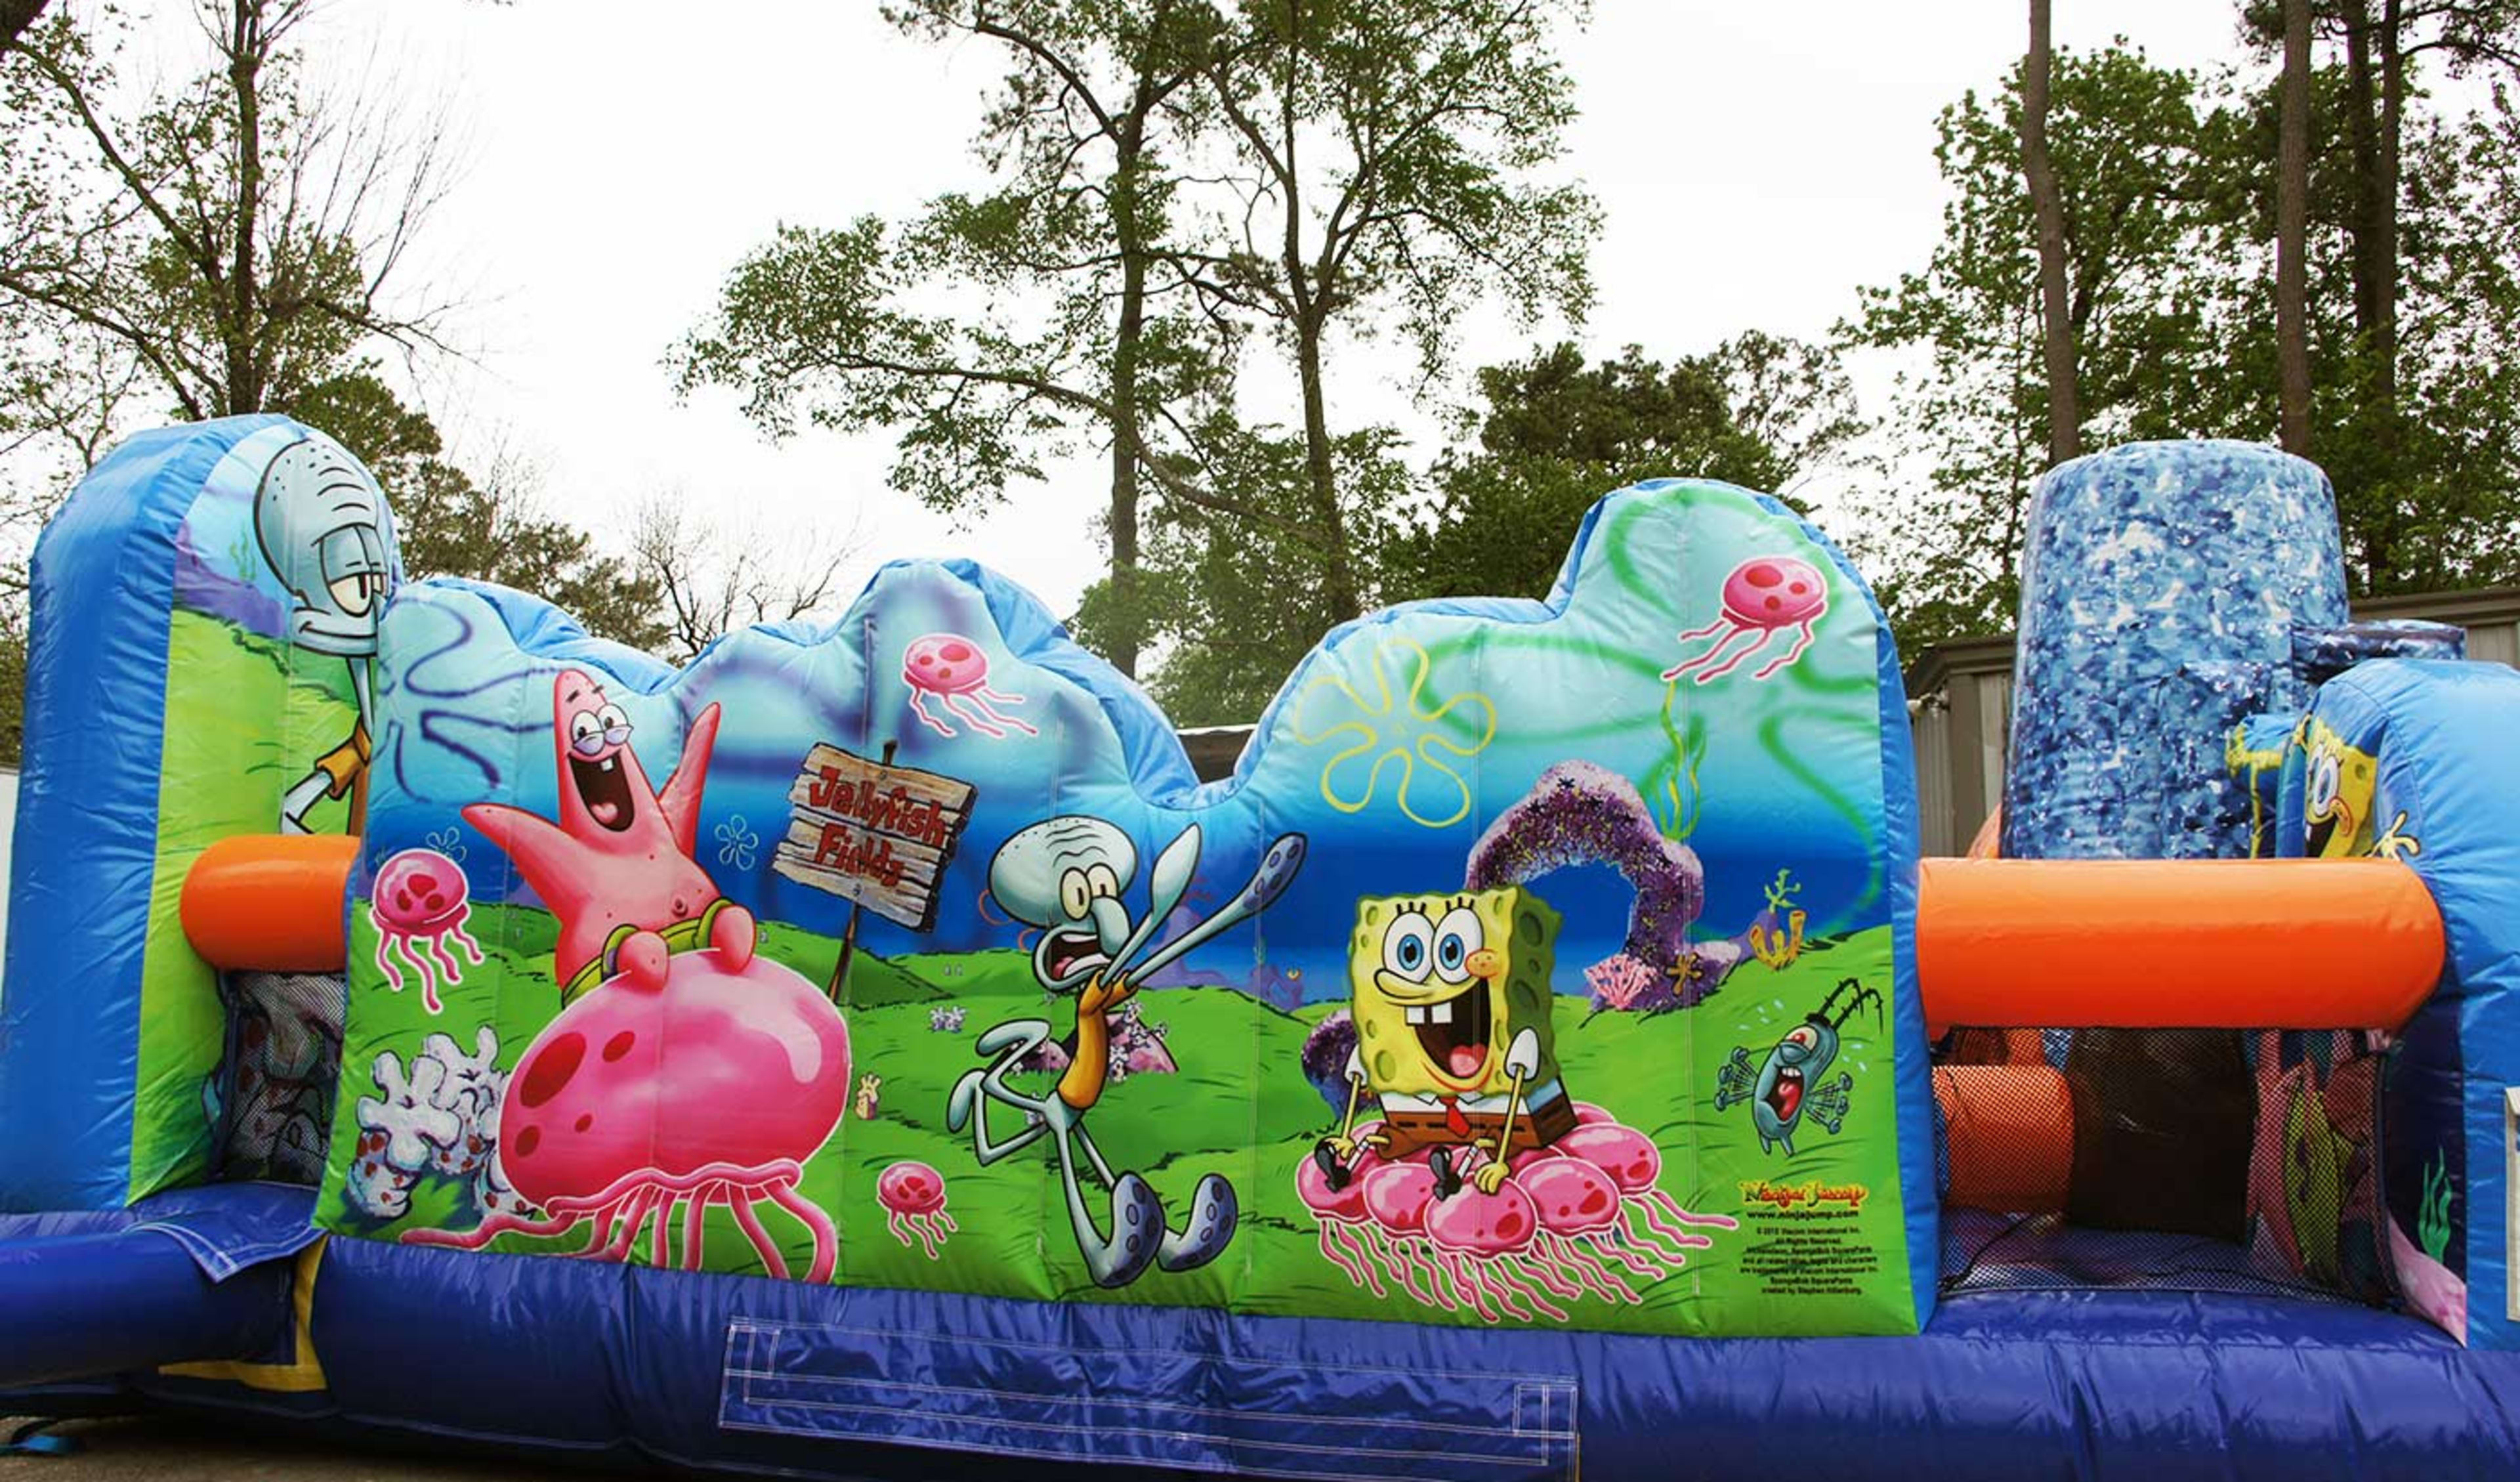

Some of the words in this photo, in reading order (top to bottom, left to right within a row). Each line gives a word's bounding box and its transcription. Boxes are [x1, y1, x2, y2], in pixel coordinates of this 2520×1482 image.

[808, 765, 946, 847] Jellyfish
[815, 822, 906, 887] Fields
[1746, 1211, 1858, 1221] www.ninjajump.com
